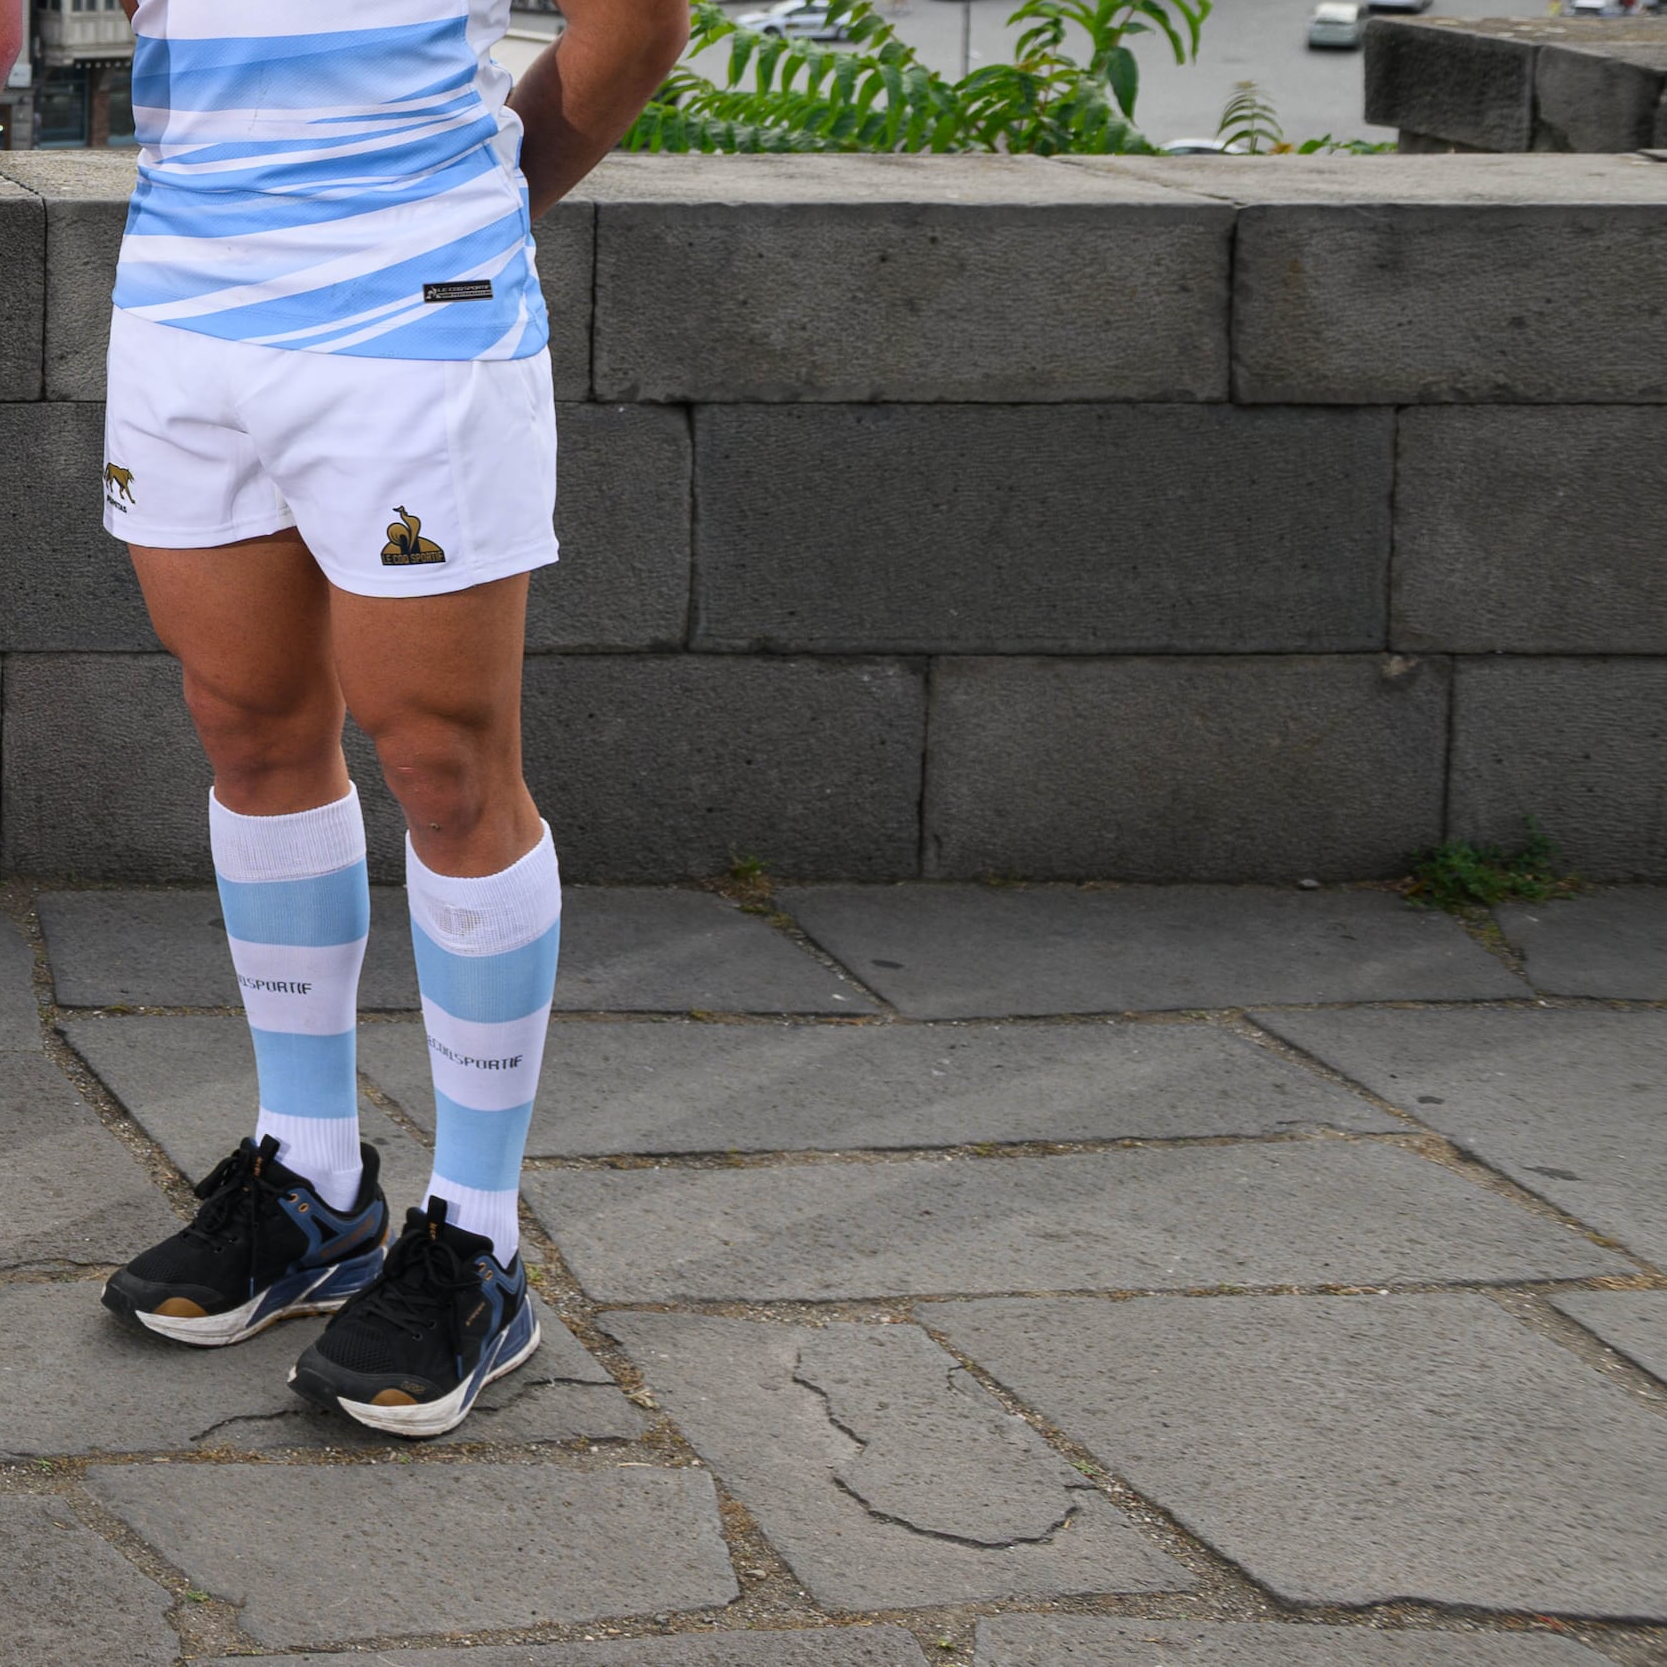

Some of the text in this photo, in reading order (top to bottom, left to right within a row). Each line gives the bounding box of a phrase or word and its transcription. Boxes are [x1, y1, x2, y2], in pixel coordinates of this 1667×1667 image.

[410, 551, 443, 563] SPORTIF
[247, 977, 312, 995] SPORTIF
[454, 1053, 523, 1070] SPORTIF
